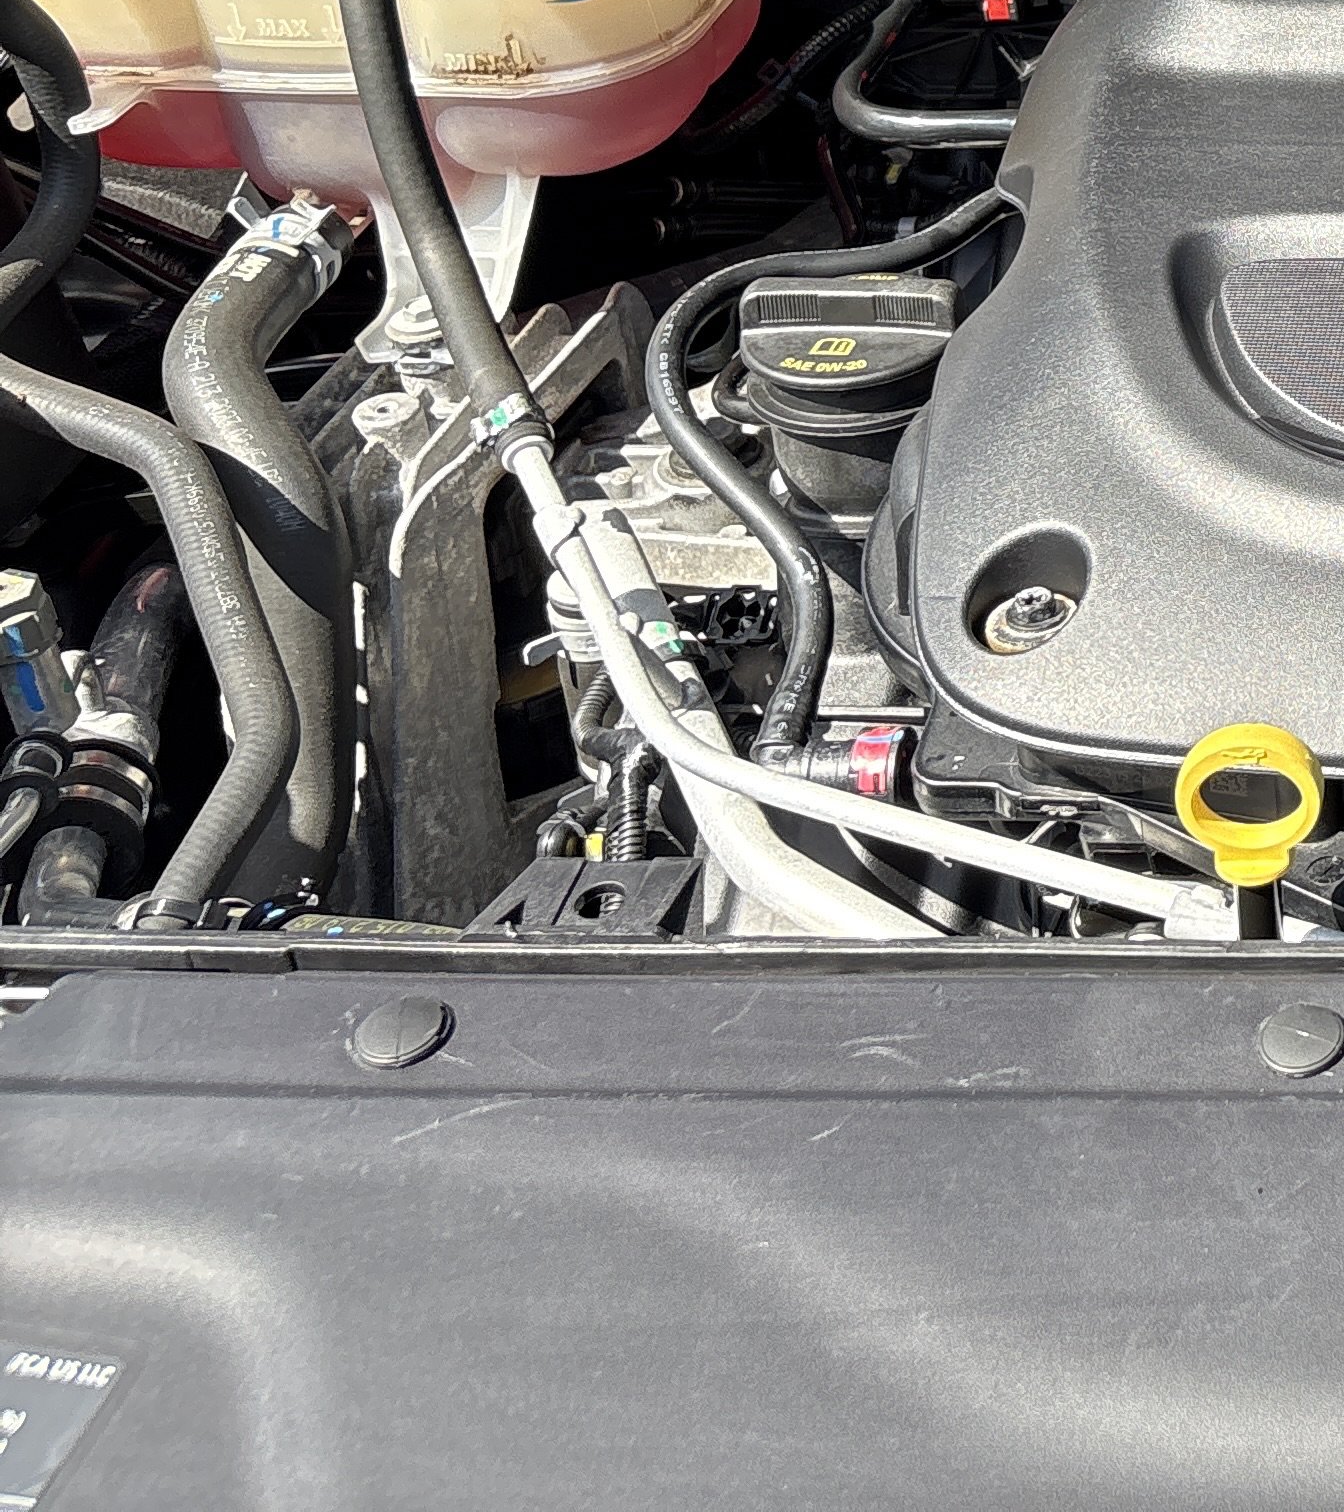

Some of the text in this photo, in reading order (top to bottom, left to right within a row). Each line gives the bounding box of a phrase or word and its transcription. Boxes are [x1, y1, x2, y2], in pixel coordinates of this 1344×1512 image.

[255, 17, 310, 37] MAX
[779, 357, 868, 373] SAE 0W-20
